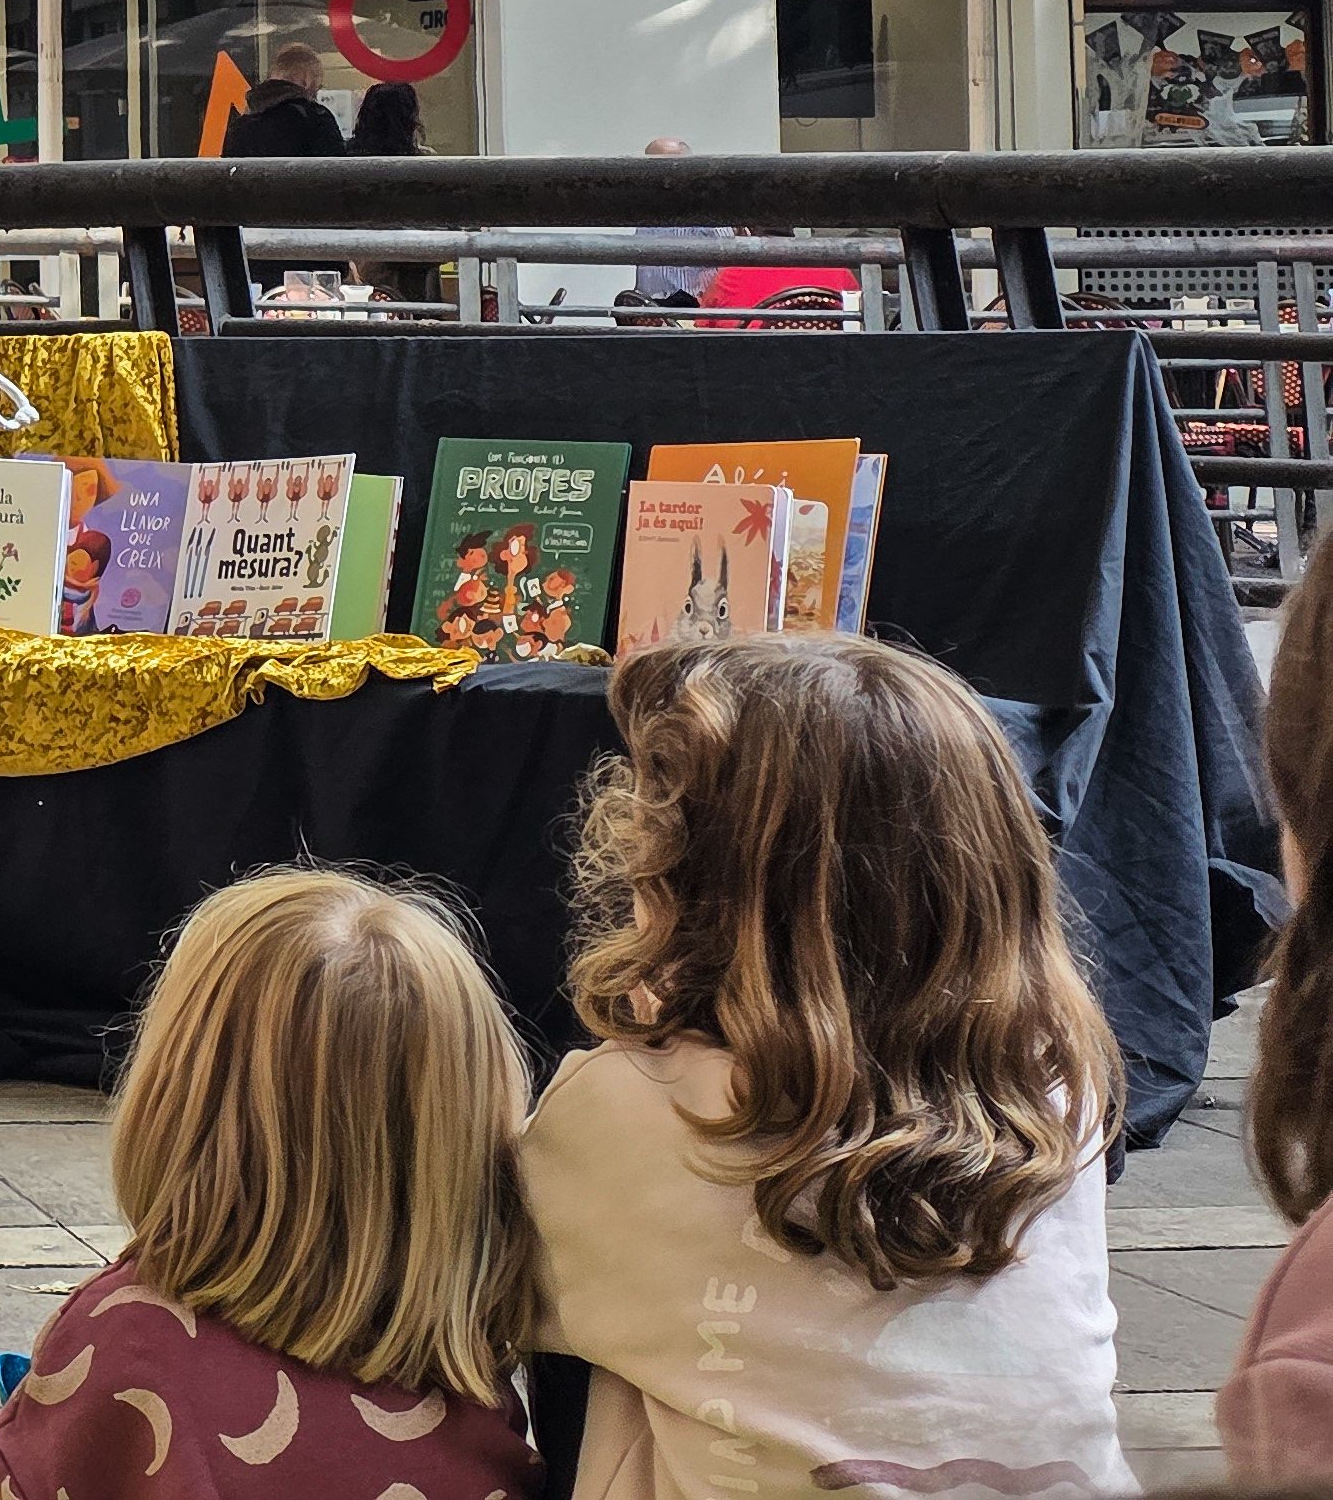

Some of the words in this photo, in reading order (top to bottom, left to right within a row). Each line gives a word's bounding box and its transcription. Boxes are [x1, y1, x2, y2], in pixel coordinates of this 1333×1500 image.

[456, 467, 595, 503] PROFES
[130, 492, 159, 506] UNA
[639, 501, 656, 513] La
[660, 502, 702, 514] tardor
[121, 510, 170, 532] LLAVOR
[635, 516, 650, 531] ja
[653, 516, 666, 529] és
[669, 517, 704, 532] aquí!
[129, 533, 153, 546] QUE
[233, 527, 295, 557] Quant
[117, 548, 163, 569] CREIX
[218, 550, 303, 579] mesura?
